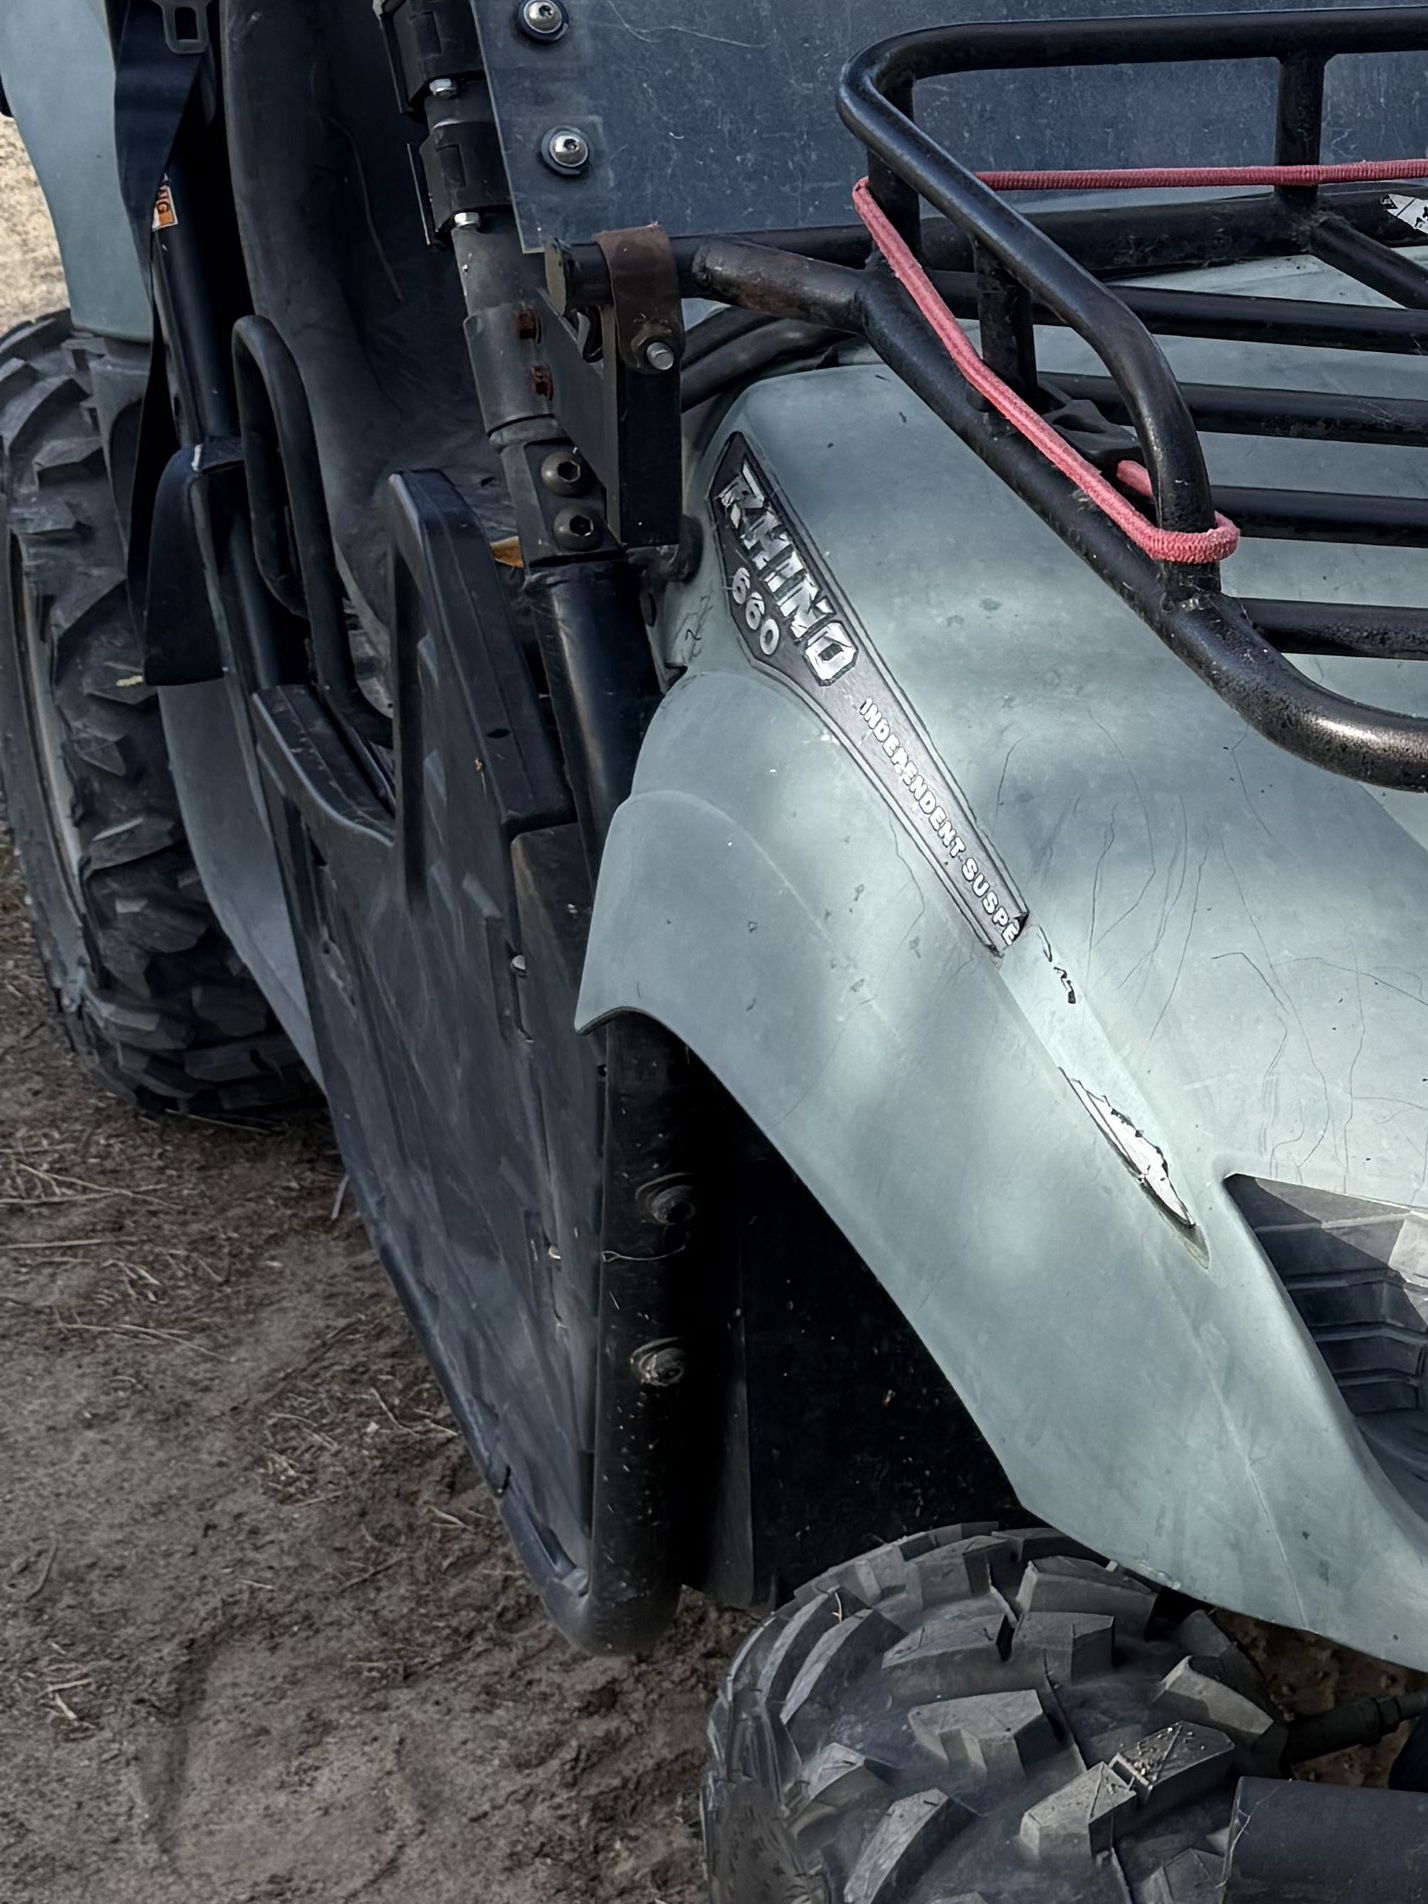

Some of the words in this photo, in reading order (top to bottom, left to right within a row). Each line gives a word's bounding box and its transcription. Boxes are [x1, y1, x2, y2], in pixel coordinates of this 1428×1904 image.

[714, 458, 857, 682] RHINO
[731, 566, 780, 656] 660
[859, 697, 966, 858] INDEPENDENT
